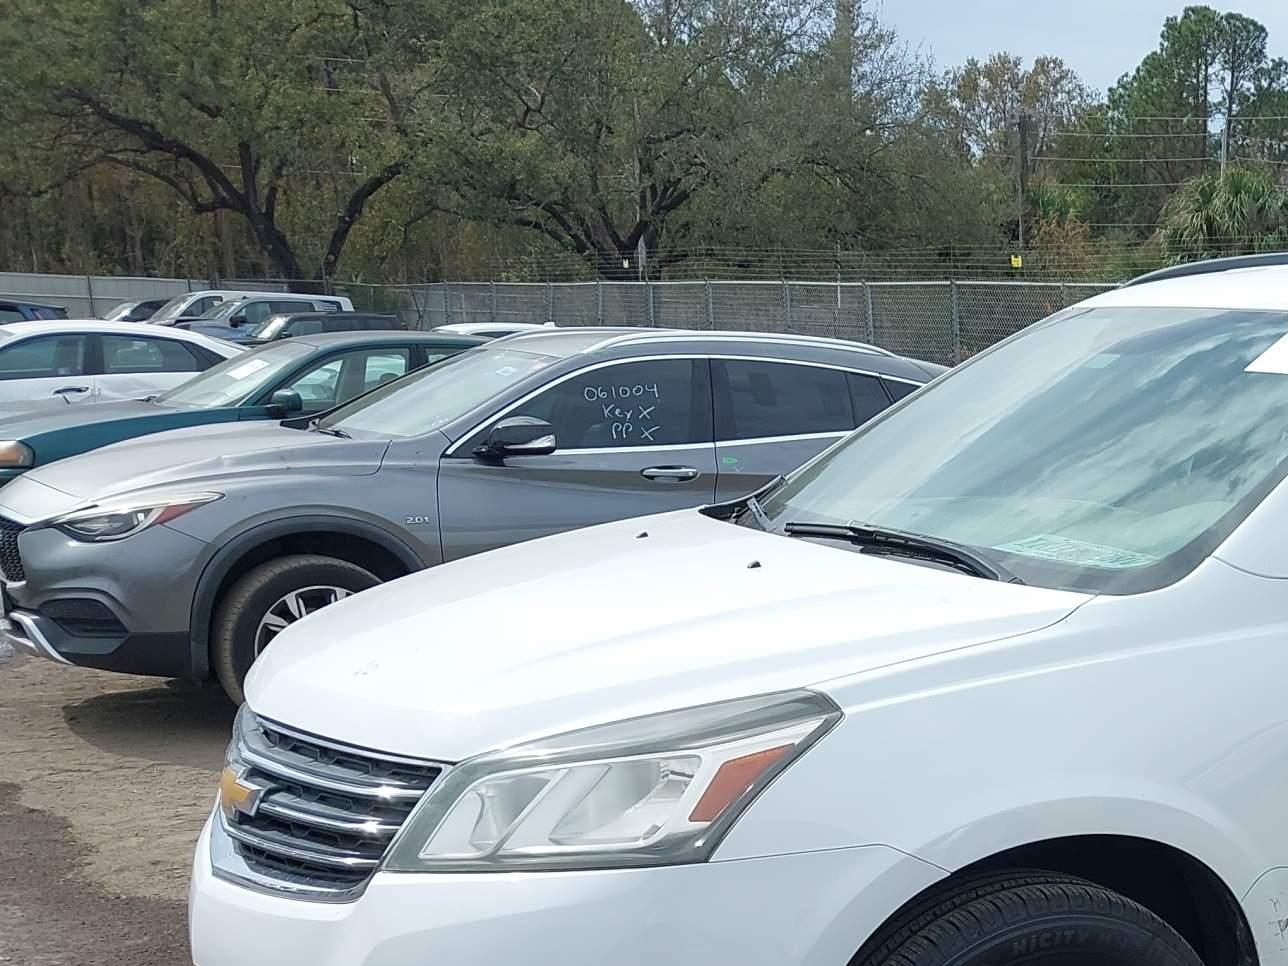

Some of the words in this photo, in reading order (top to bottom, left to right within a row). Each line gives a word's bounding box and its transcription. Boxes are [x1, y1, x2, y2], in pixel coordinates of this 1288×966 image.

[583, 383, 660, 402] 061004
[602, 404, 633, 422] Key
[638, 405, 655, 420] X
[611, 422, 633, 439] PP
[640, 425, 661, 441] X
